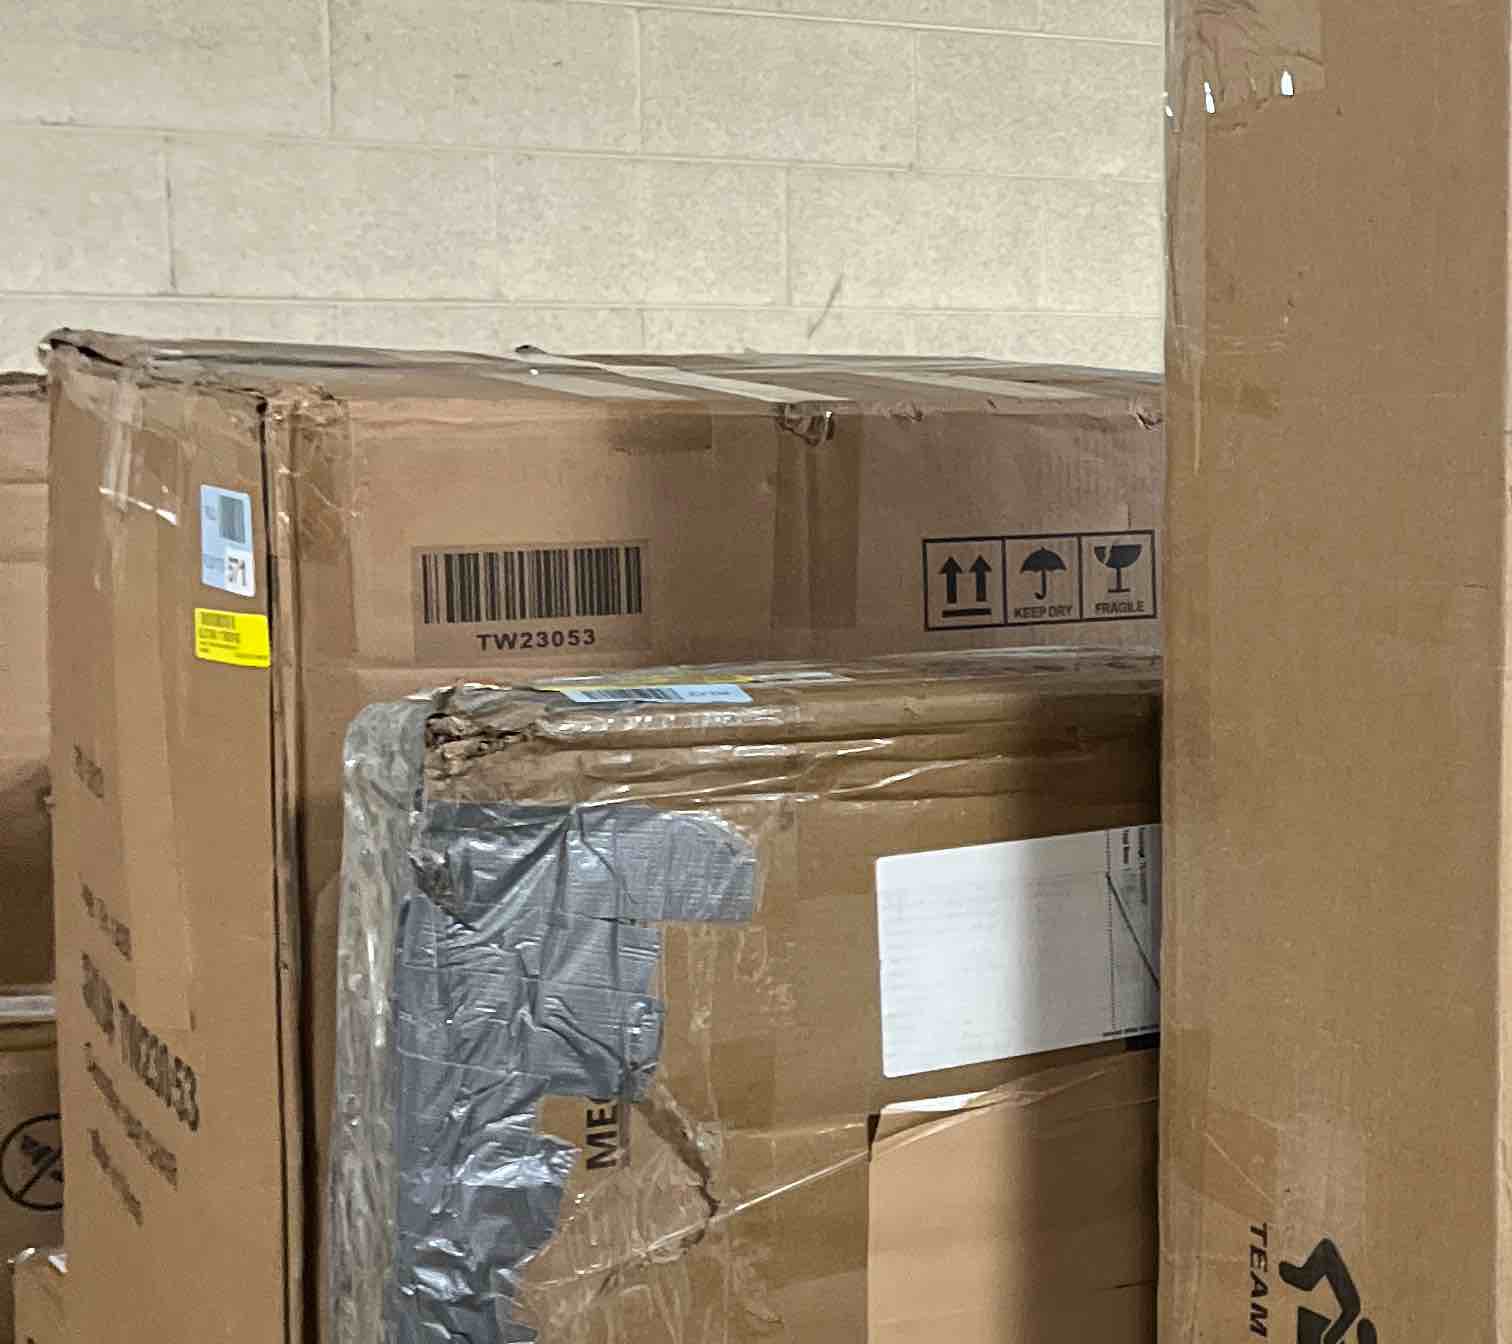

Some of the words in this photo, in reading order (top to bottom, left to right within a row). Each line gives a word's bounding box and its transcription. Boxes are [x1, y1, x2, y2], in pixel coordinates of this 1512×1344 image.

[1013, 606, 1046, 619] KEEP
[1048, 605, 1072, 618] DRY
[1094, 599, 1145, 615] FRAGILE
[477, 627, 597, 652] TW23053
[1247, 1222, 1270, 1336] TEAM
